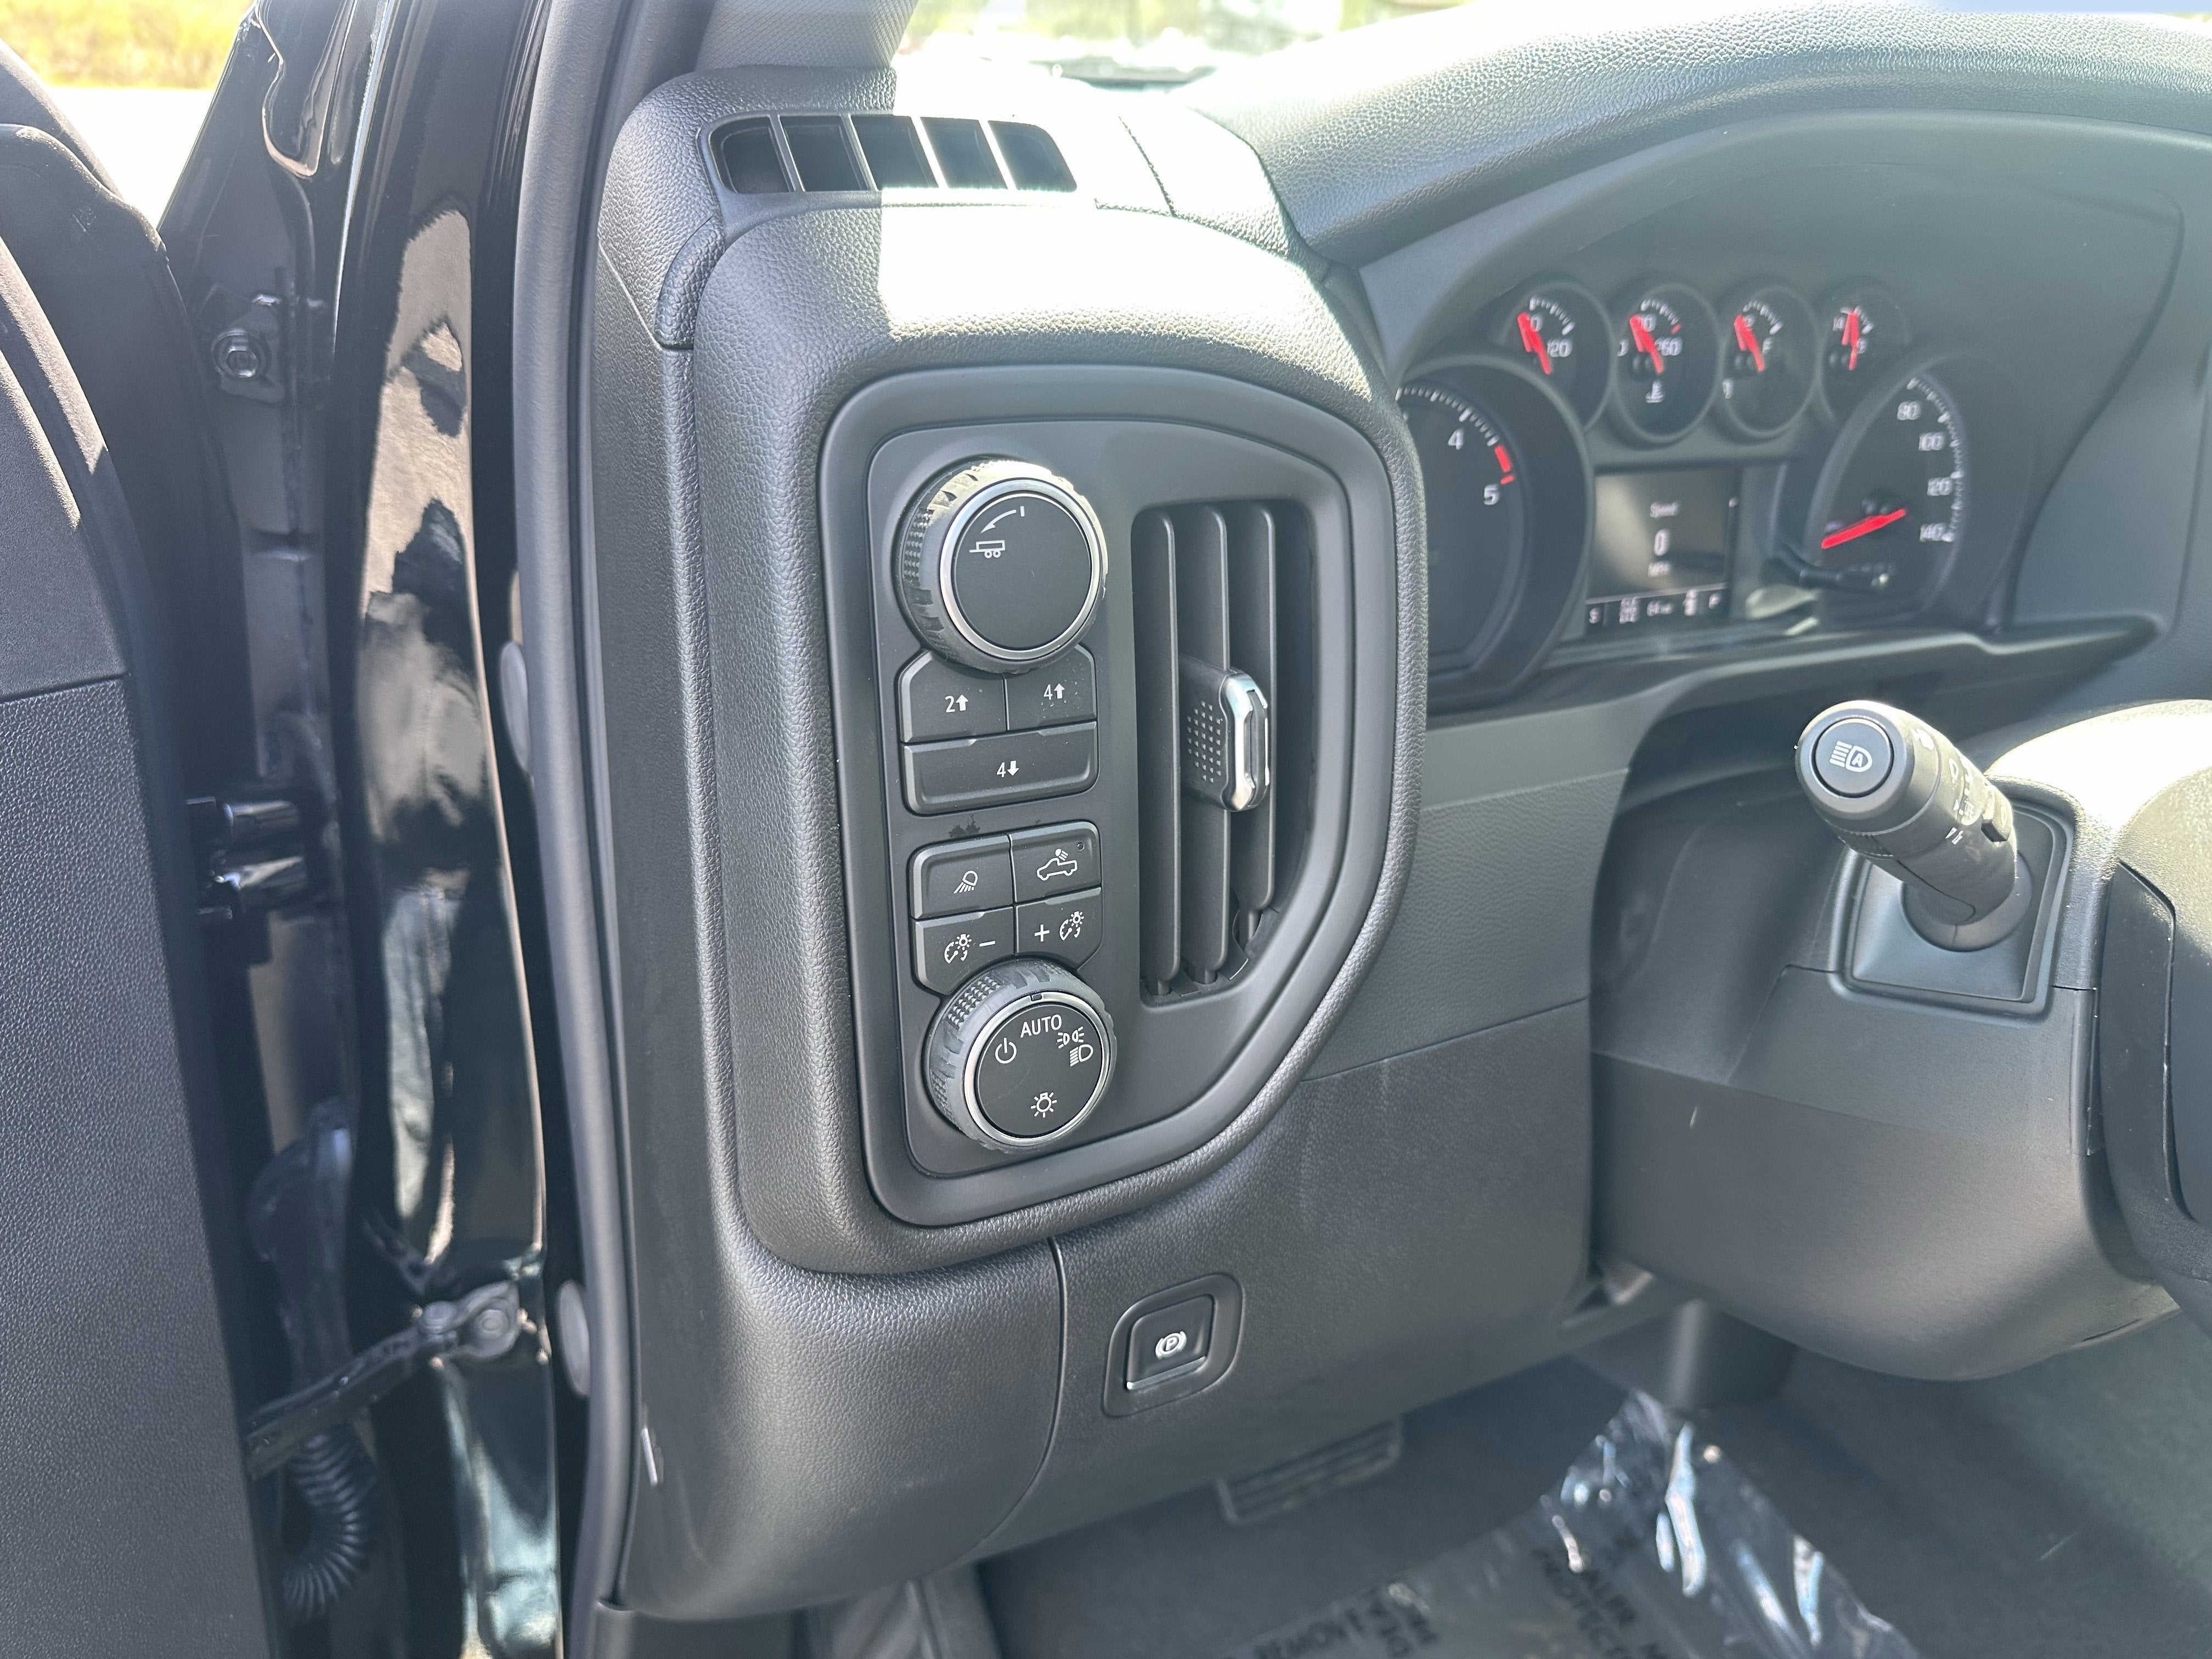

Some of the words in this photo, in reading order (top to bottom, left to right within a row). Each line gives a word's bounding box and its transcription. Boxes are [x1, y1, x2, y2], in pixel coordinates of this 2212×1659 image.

[1448, 430, 1464, 450] 4
[1483, 484, 1500, 505] 5
[1654, 530, 1668, 556] 0
[1043, 684, 1053, 699] 4
[945, 696, 955, 713] 2
[996, 762, 1006, 778] 4
[1020, 1014, 1062, 1039] AUTO
